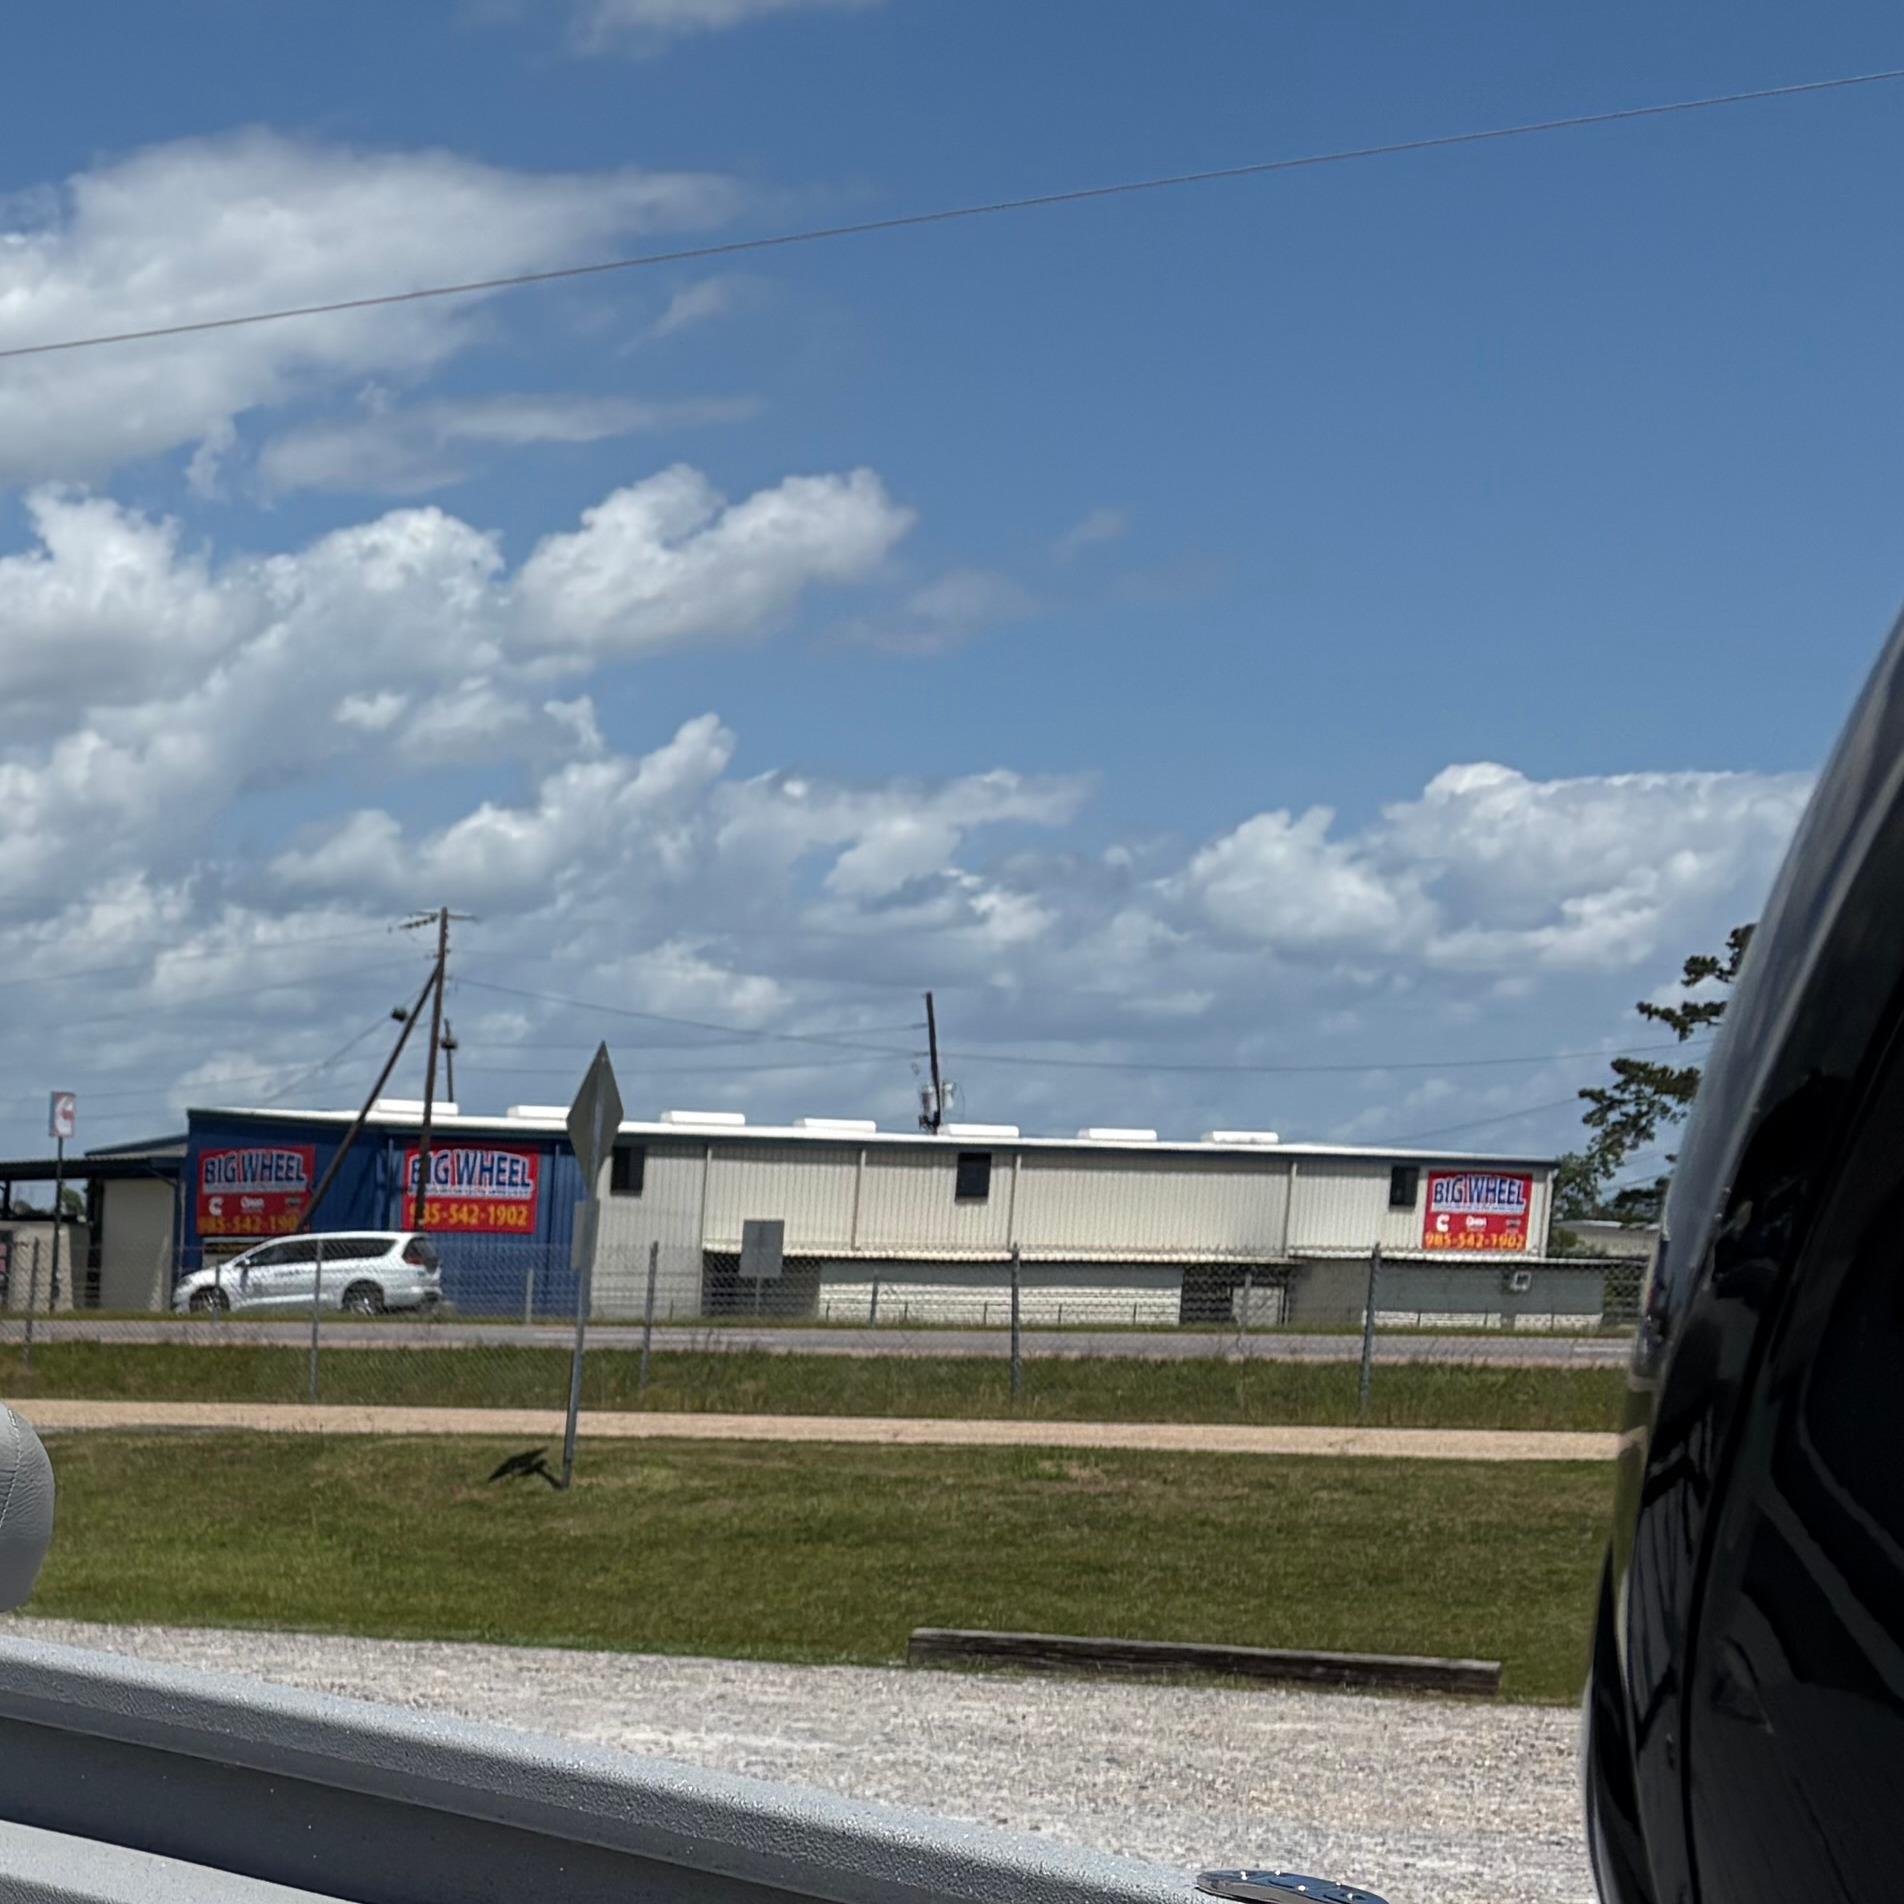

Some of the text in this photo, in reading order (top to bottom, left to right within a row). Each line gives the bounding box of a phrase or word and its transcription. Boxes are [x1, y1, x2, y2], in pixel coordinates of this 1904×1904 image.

[205, 1151, 307, 1184] BIG WHEEL
[455, 1150, 531, 1187] WHEEL
[1434, 1175, 1524, 1205] BIG WHEEL
